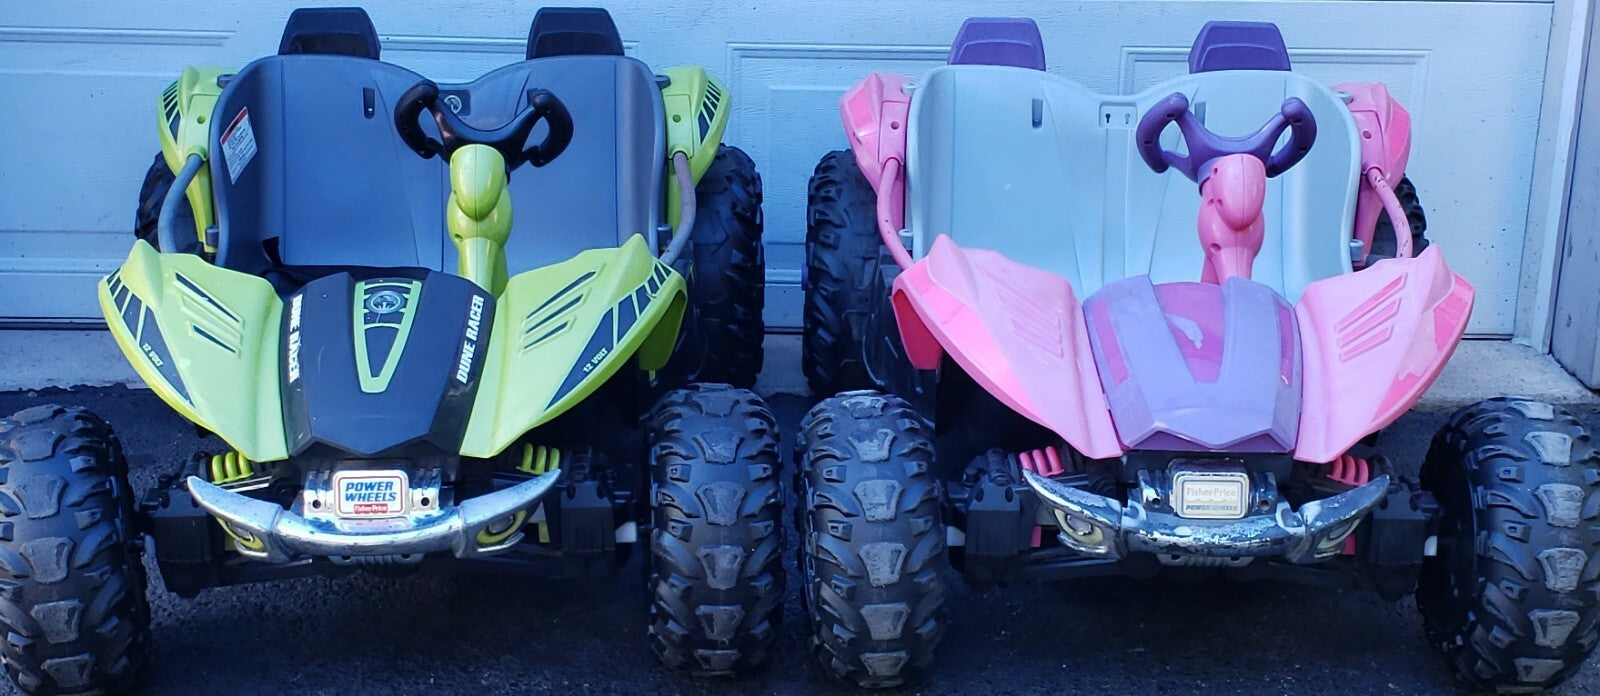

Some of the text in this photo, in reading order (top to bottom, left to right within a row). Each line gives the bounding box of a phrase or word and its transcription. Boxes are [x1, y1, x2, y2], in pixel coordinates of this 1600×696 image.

[456, 294, 485, 384] DUNE RACER
[582, 347, 608, 373] 12 VOLT
[345, 481, 394, 492] POWER
[345, 492, 397, 502] WHEELS
